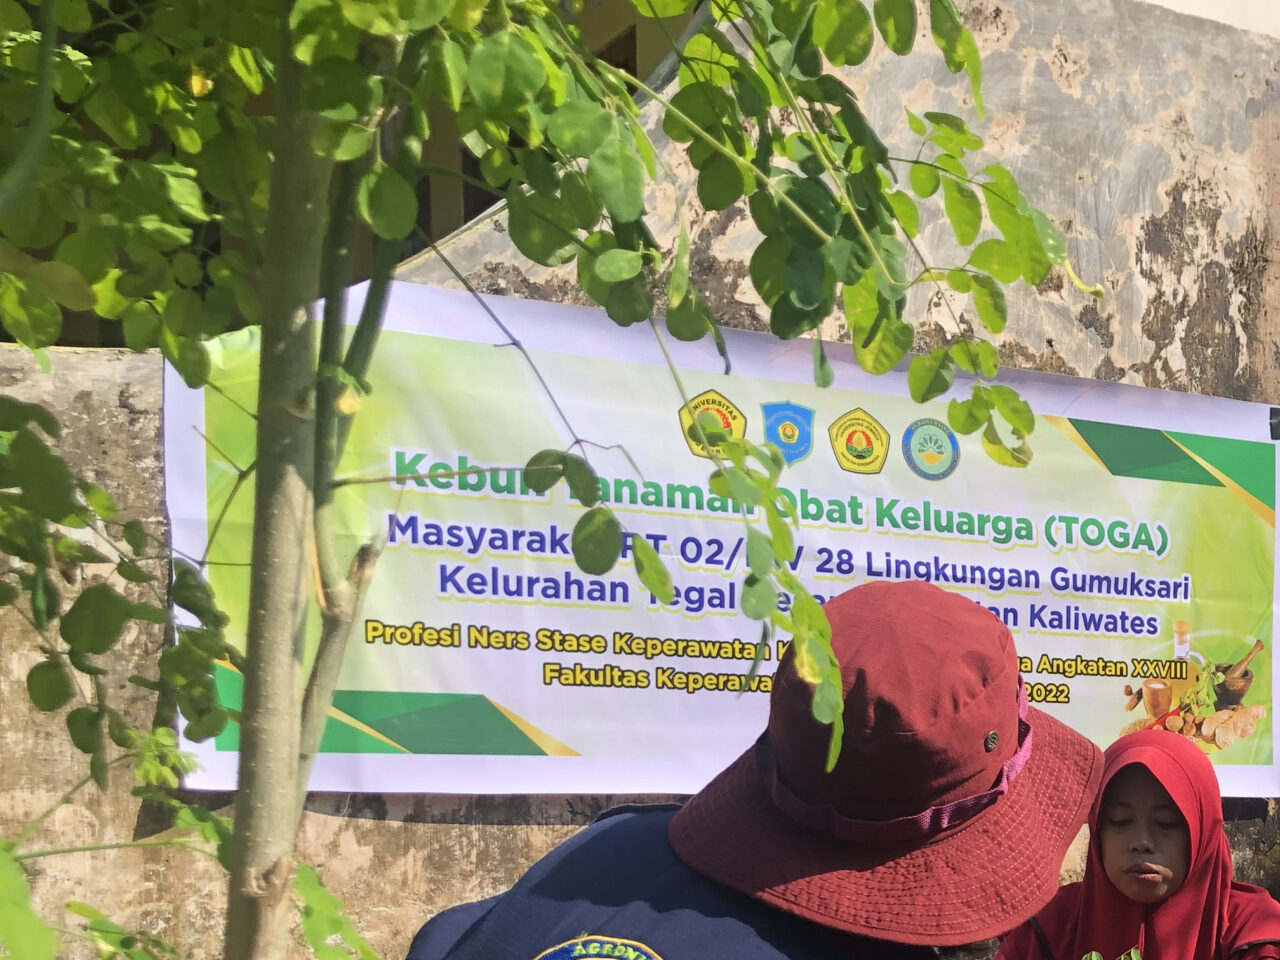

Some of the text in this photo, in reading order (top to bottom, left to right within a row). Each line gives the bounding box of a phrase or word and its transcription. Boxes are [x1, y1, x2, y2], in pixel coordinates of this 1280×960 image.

[689, 399, 738, 421] NIVERSITAS
[563, 464, 755, 516] anama
[773, 487, 863, 525] Obat
[876, 497, 1034, 544] Keluarga
[1045, 515, 1169, 556] (TOGA)
[388, 514, 573, 556] Masyarak
[680, 536, 804, 571] 02/
[816, 547, 855, 575] 28
[866, 551, 1040, 590] Lingkungan
[1050, 567, 1189, 600] Gumuksari
[440, 565, 629, 603] Kelurahan
[1029, 604, 1158, 635] Kaliwates
[365, 620, 460, 648] Profesi
[467, 626, 529, 650] Ners
[536, 629, 606, 654] Stase
[613, 632, 771, 661] Keperawatan
[1037, 653, 1127, 678] Angkatan
[1131, 658, 1188, 679] XXVIII
[543, 663, 1070, 703] Fakultas Keperawa 2022
